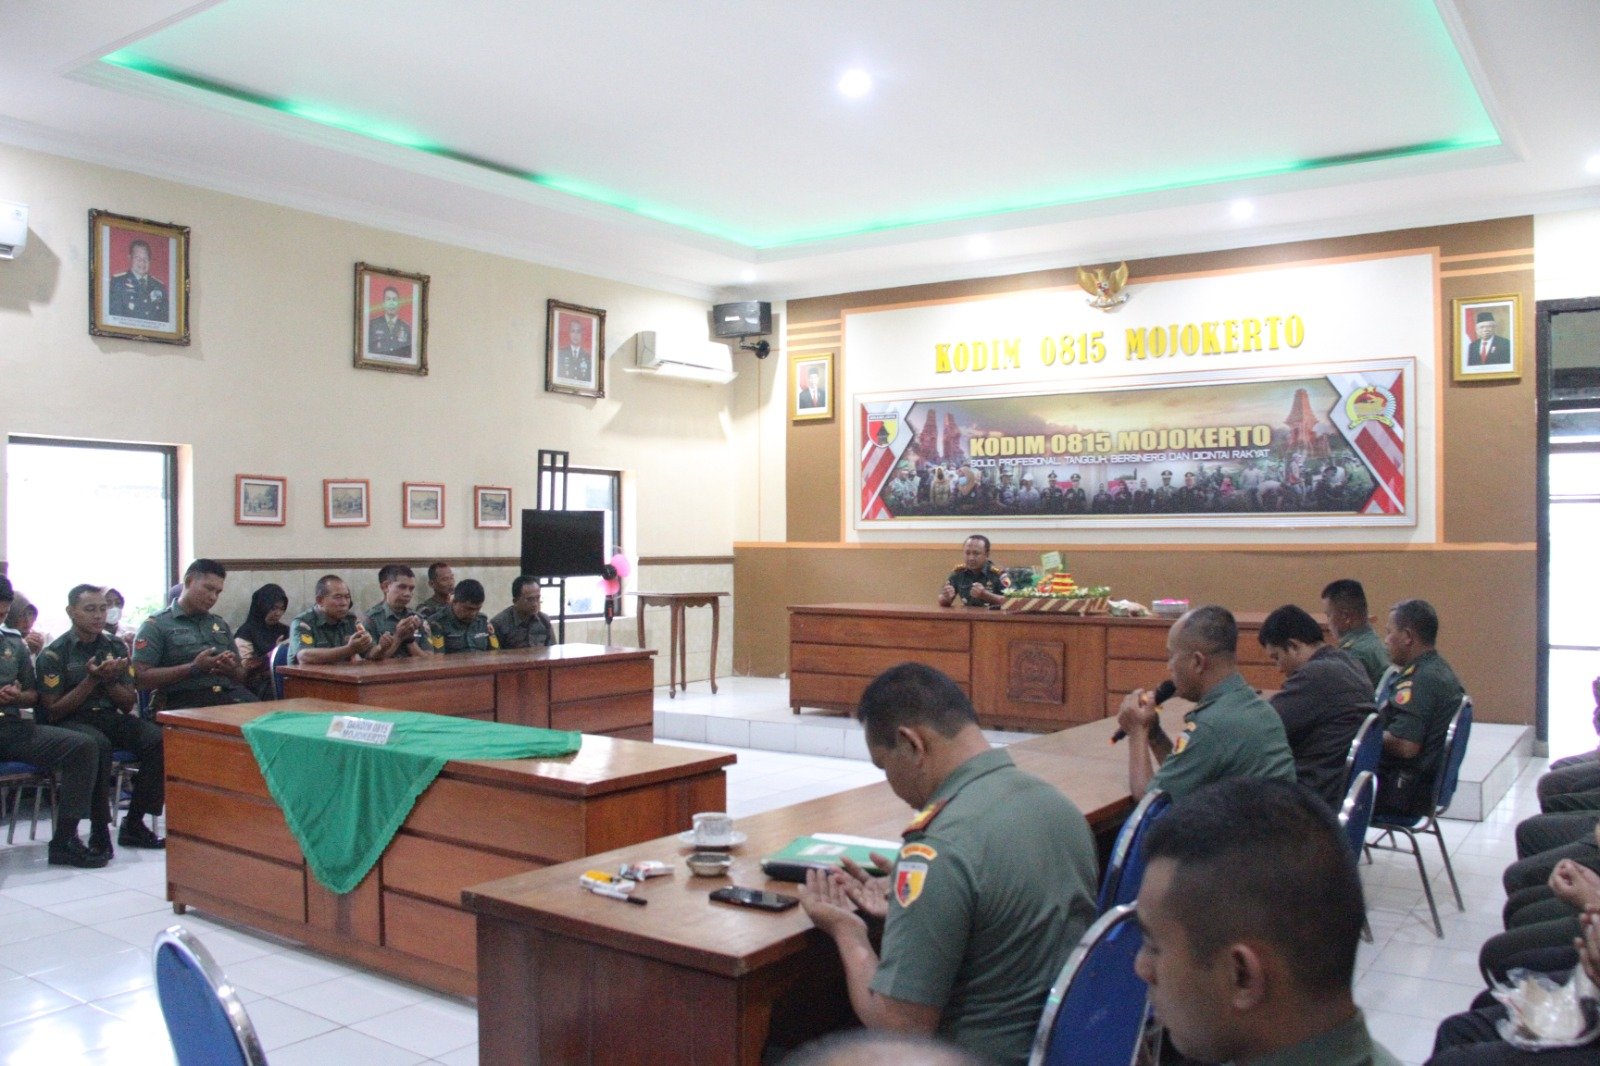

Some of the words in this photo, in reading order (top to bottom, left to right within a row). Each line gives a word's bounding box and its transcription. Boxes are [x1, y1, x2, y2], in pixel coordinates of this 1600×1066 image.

[935, 336, 1021, 373] KODIM
[1040, 331, 1107, 366] 0815
[1125, 313, 1305, 360] MOJOKERTO
[970, 435, 1046, 457] KODIM
[1051, 432, 1112, 454] 0815
[1118, 425, 1271, 451] MOJOKERTO
[1232, 448, 1271, 459] RAKYAT
